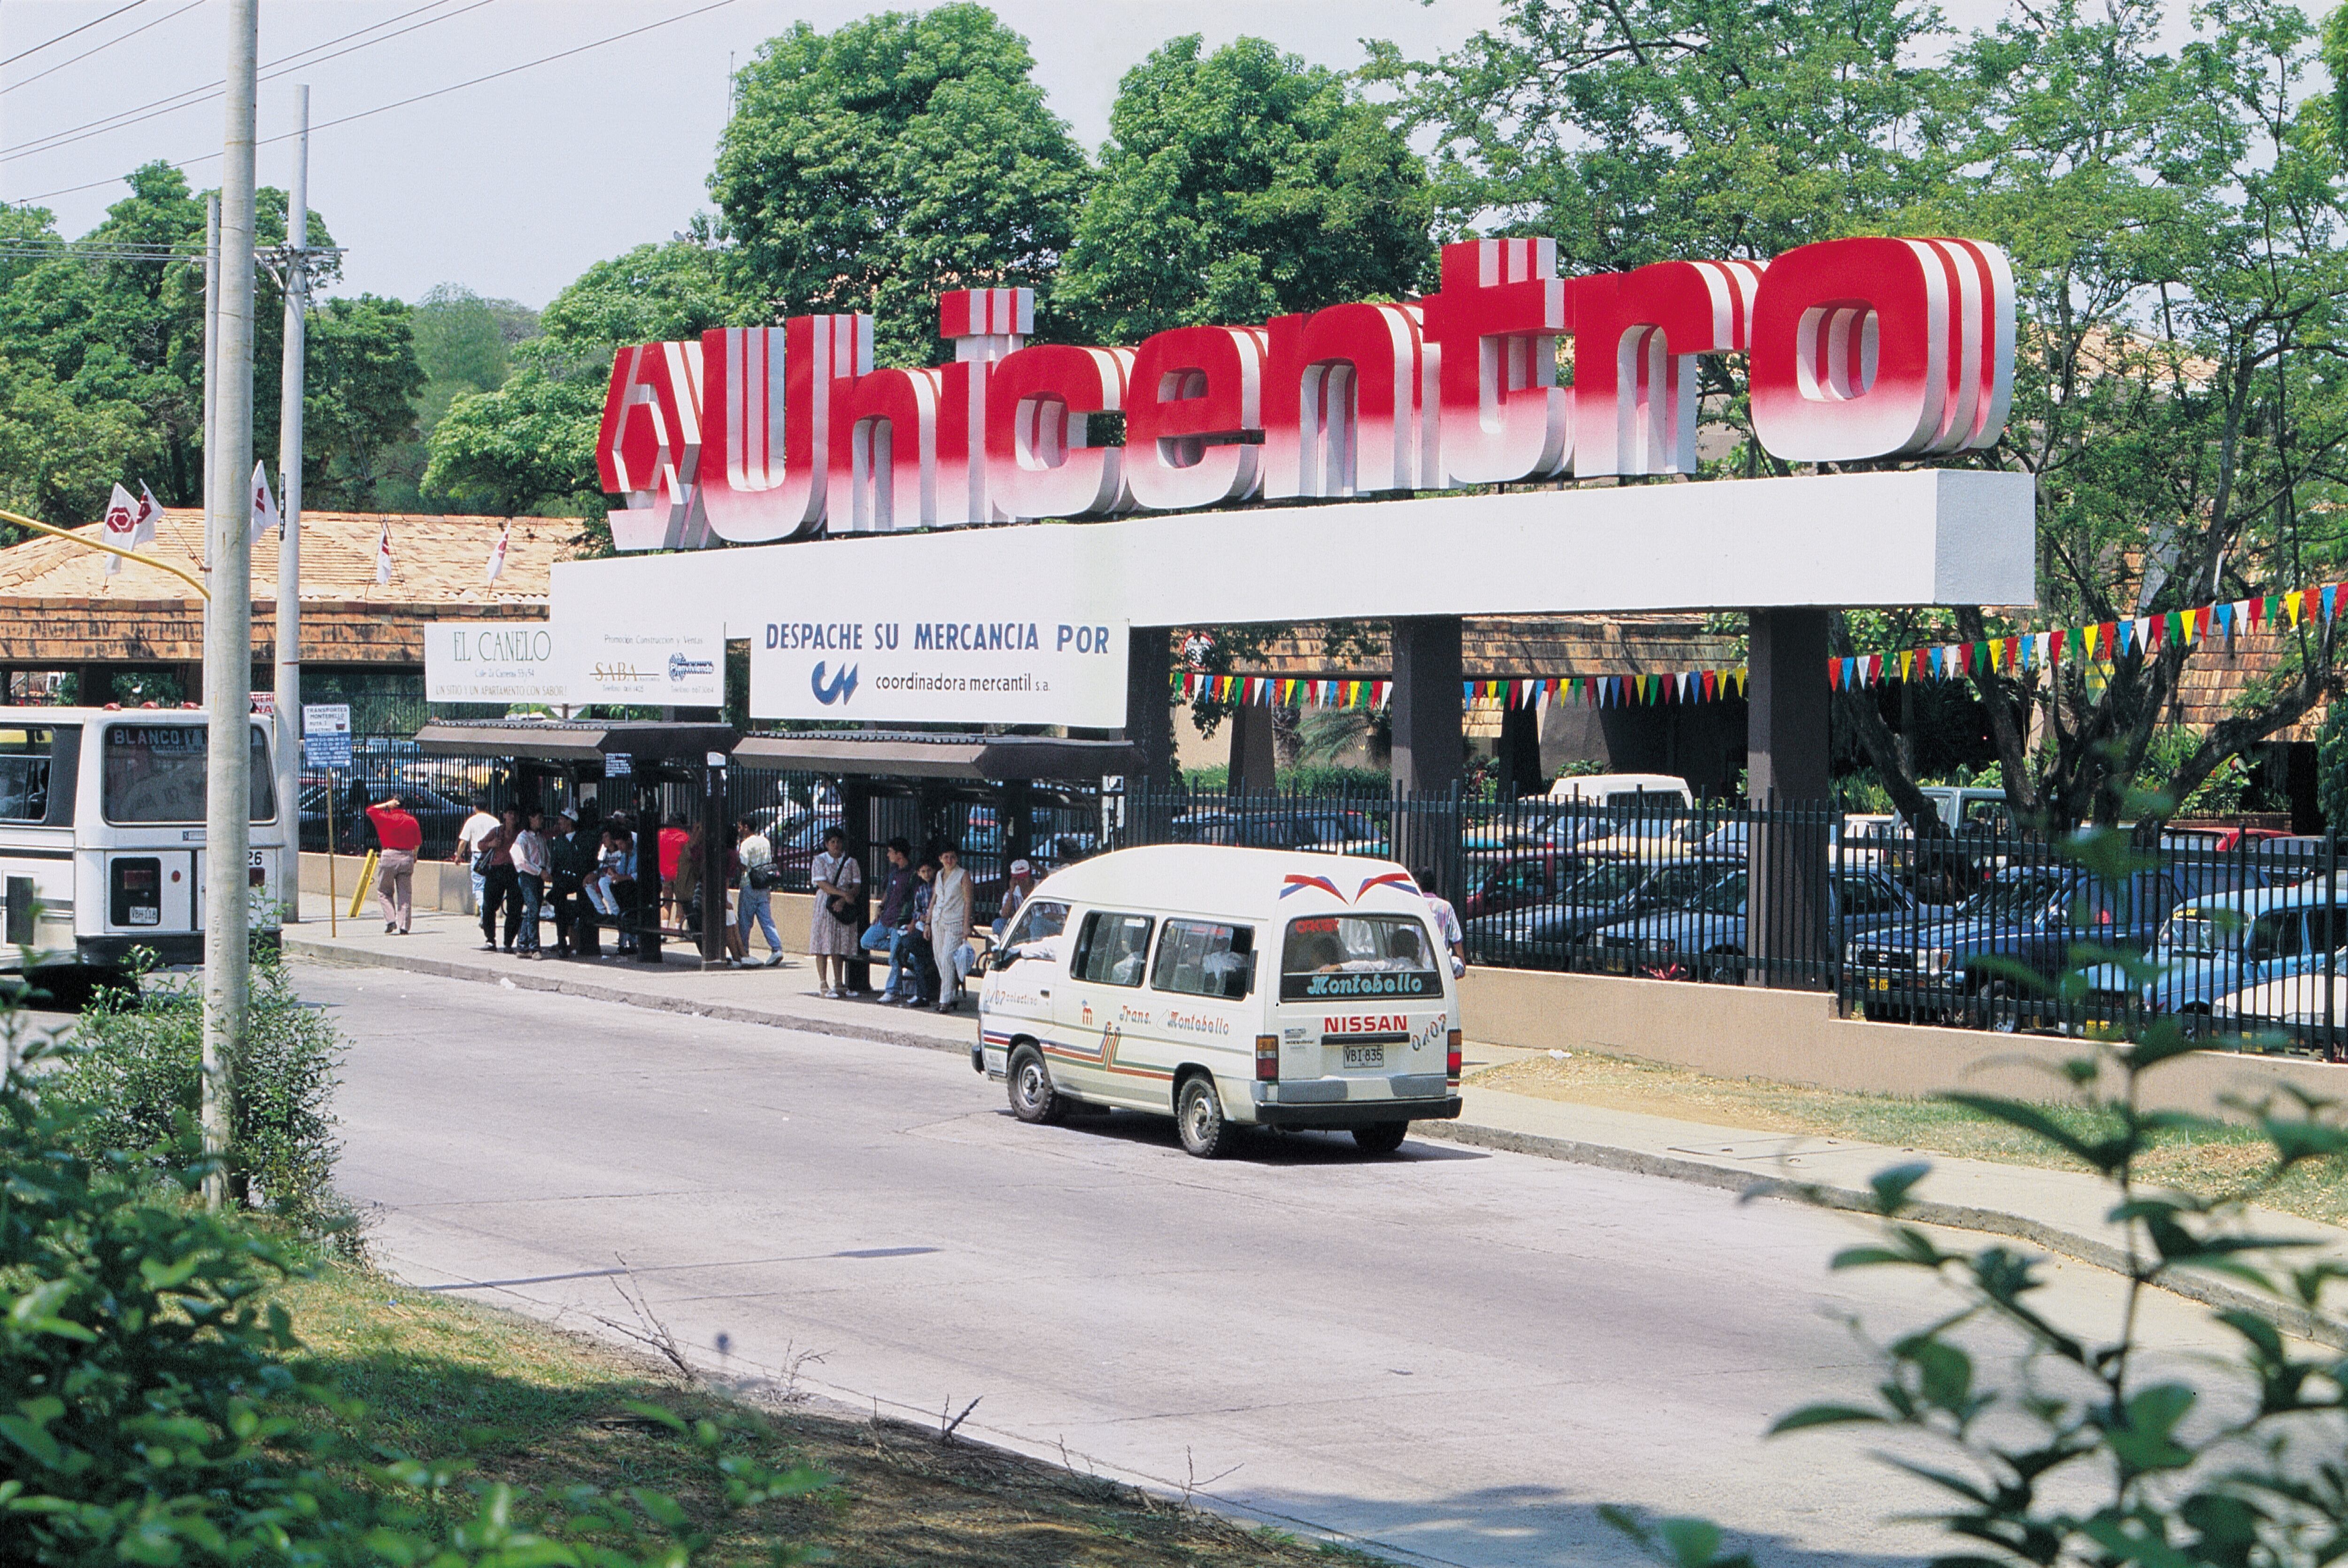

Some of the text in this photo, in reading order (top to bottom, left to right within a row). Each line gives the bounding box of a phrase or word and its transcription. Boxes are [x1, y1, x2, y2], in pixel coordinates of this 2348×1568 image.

[704, 236, 2013, 543] Unicentro
[454, 630, 551, 662] EL CANELO
[684, 636, 703, 645] Ventas
[766, 623, 1110, 654] DESPACHE SU MERCANCIA POR
[595, 662, 637, 681] SABA
[436, 685, 445, 695] UN
[447, 685, 462, 695] SITIO
[470, 685, 478, 695] UN
[481, 685, 525, 696] APARTAMENTO
[526, 685, 540, 696] CON
[876, 672, 1051, 692] coordinadora mercantil s.a.
[114, 729, 180, 745] BLANCO
[1324, 1015, 1407, 1033] NISSAN
